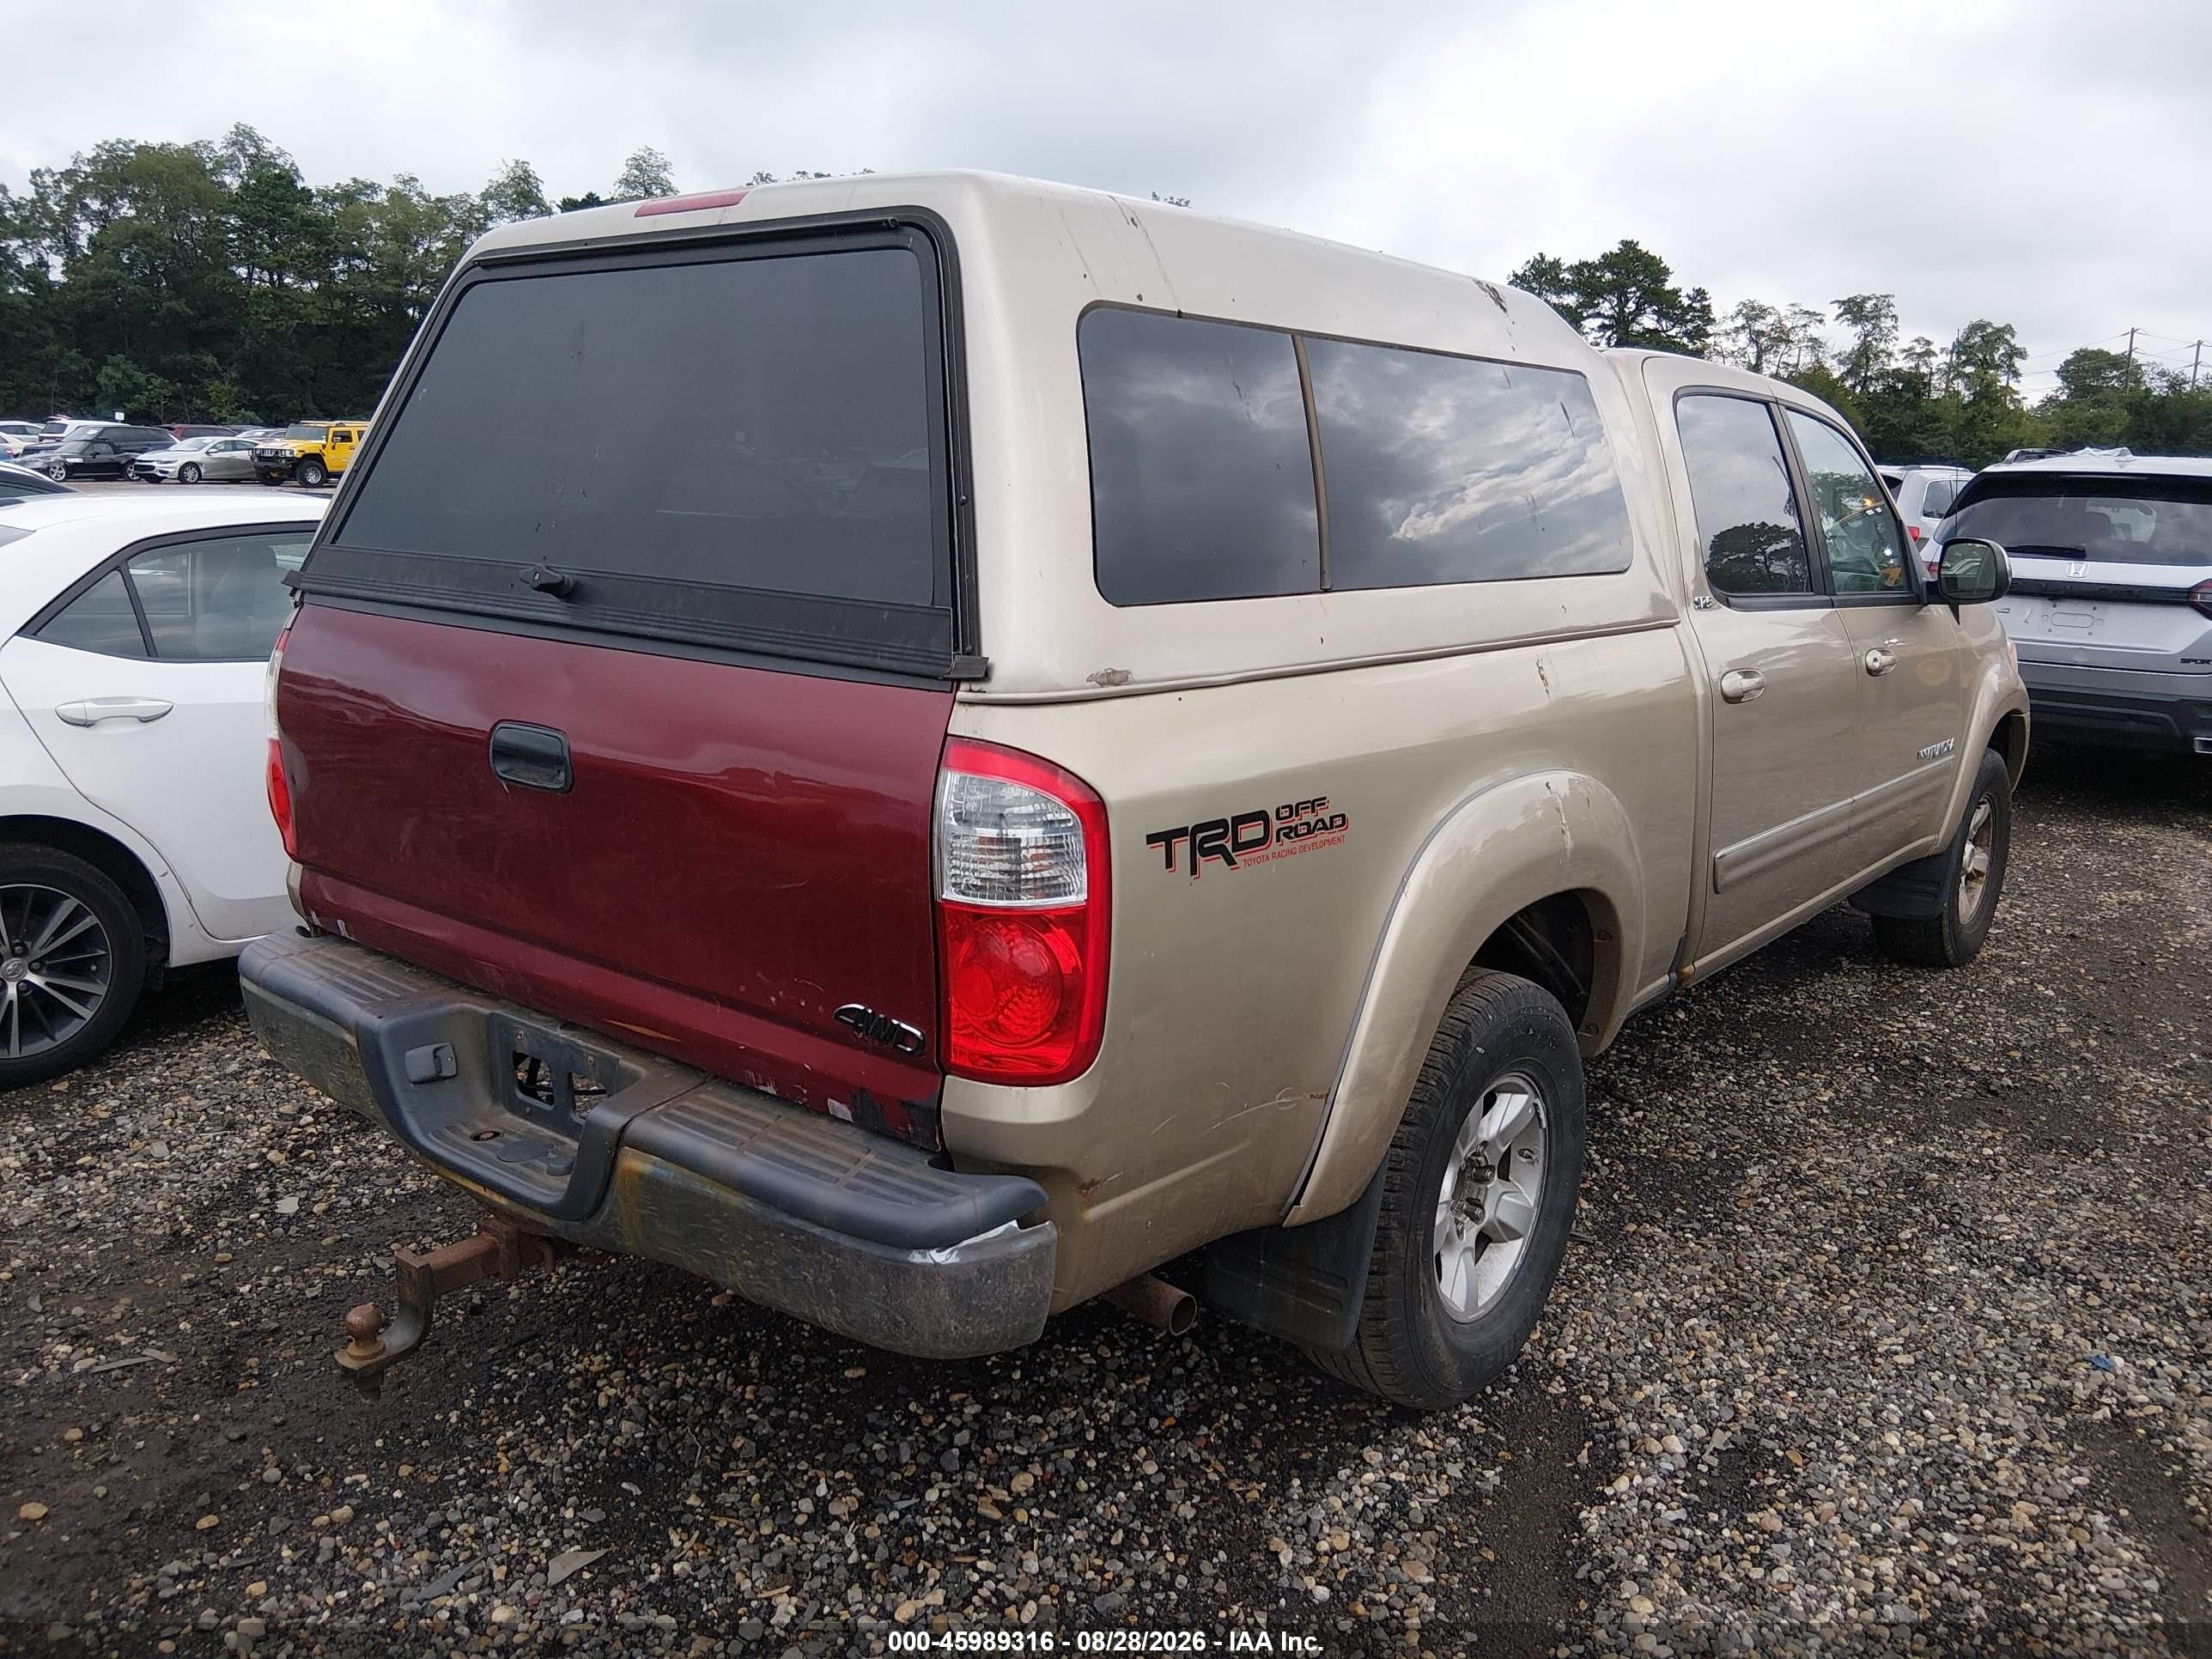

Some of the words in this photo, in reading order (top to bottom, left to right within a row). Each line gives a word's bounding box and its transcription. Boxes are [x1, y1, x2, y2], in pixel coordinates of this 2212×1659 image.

[1275, 796, 1330, 824] OFF
[1146, 809, 1273, 881] TRD
[1275, 812, 1350, 846] ROAD
[1243, 853, 1270, 868] TOYOTA
[1271, 847, 1297, 861] RACING
[1298, 835, 1346, 854] DEVELOPMENT
[831, 1002, 927, 1055] 4WD
